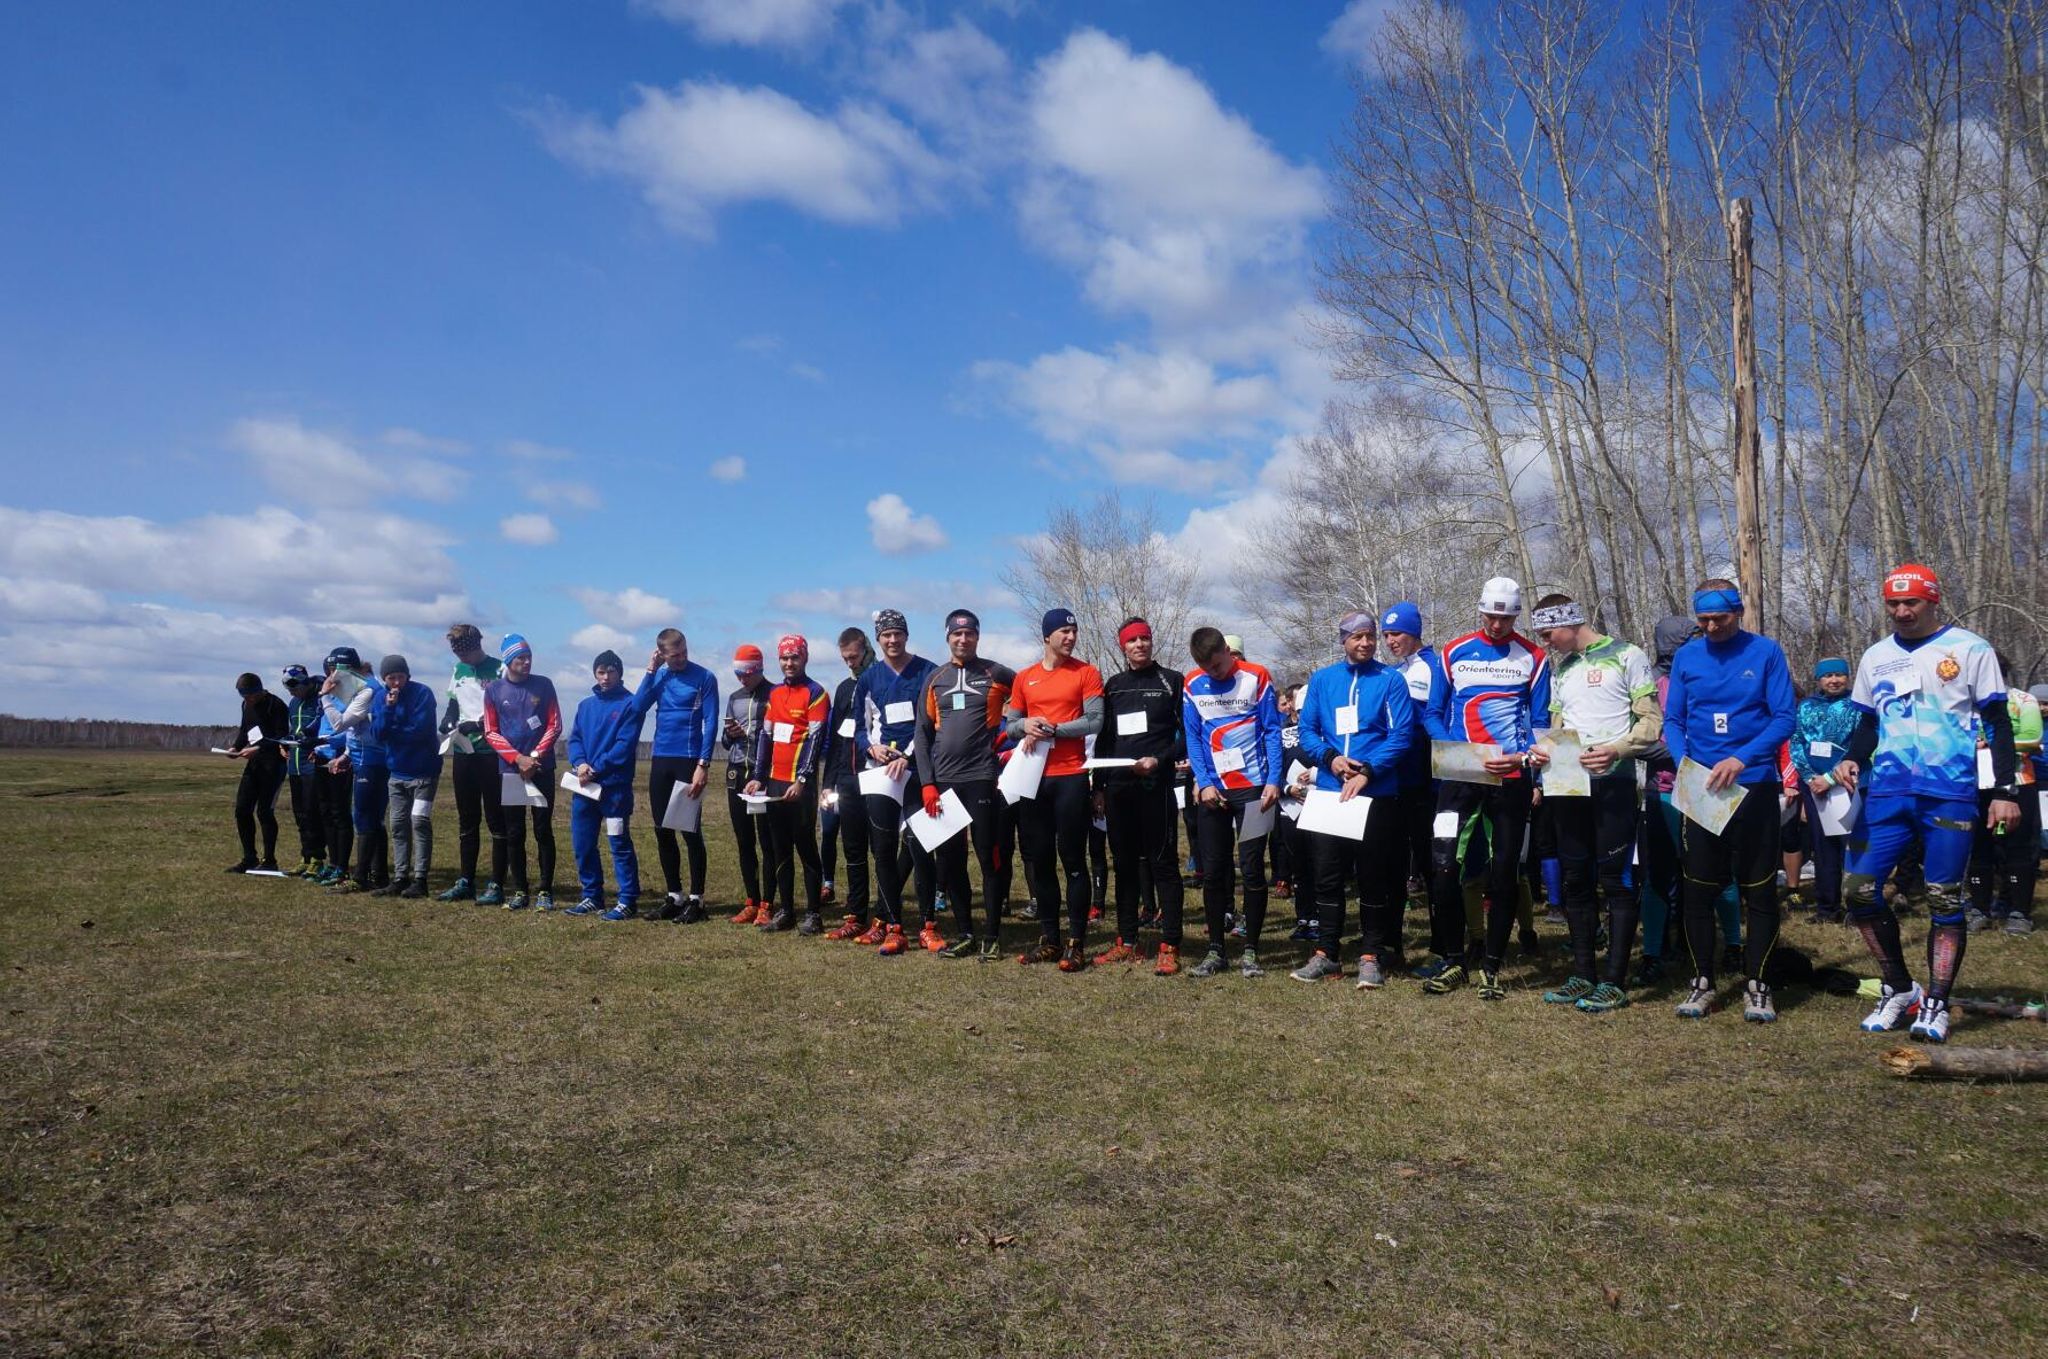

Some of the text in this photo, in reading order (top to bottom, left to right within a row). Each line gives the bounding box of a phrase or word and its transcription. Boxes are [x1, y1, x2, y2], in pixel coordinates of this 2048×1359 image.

[1458, 664, 1522, 676] Orienteering
[1198, 699, 1248, 707] Orienteering
[1716, 718, 1726, 729] 2
